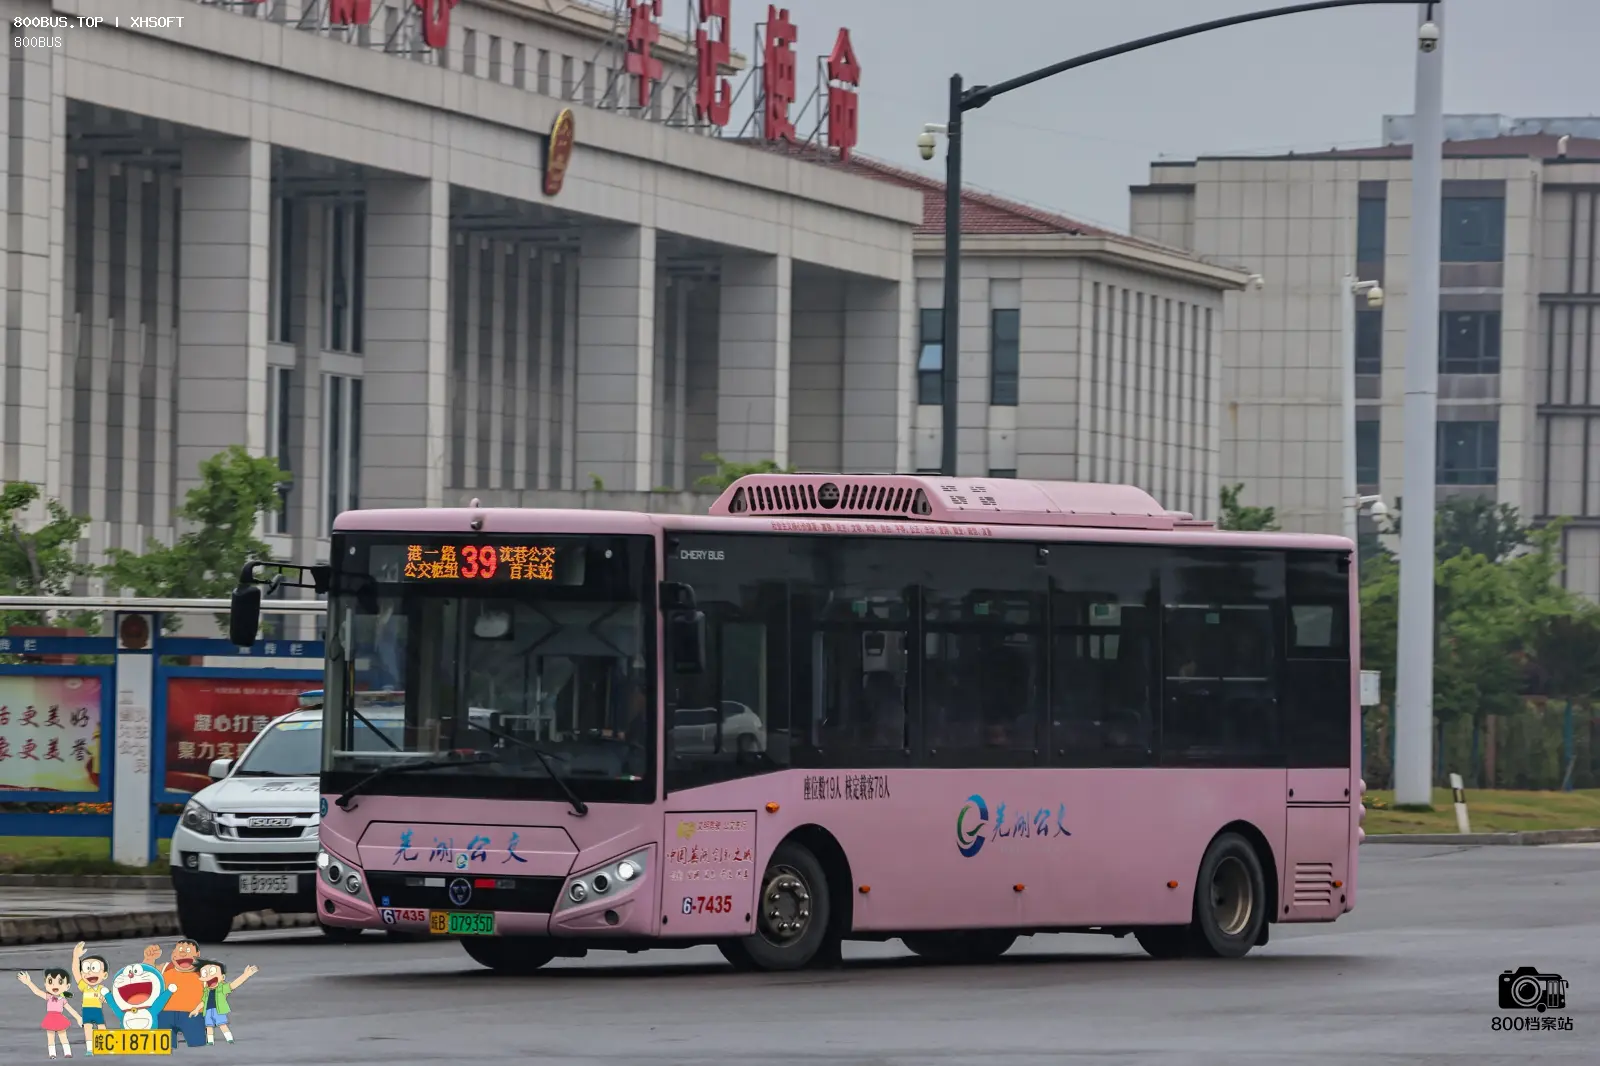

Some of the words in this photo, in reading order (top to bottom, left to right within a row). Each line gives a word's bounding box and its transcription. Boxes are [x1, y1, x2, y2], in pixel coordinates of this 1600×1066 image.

[460, 545, 498, 579] 39
[680, 549, 707, 560] CHERY
[707, 550, 725, 560] BUS
[509, 562, 553, 580] 首末站
[194, 714, 281, 732] 凝心打造
[804, 775, 842, 801] 座位数19人
[845, 775, 890, 801] 核定载客78人
[991, 801, 1073, 842] 芜湖公交
[393, 828, 528, 865] 芜湖公交
[682, 895, 732, 914] 6-7435
